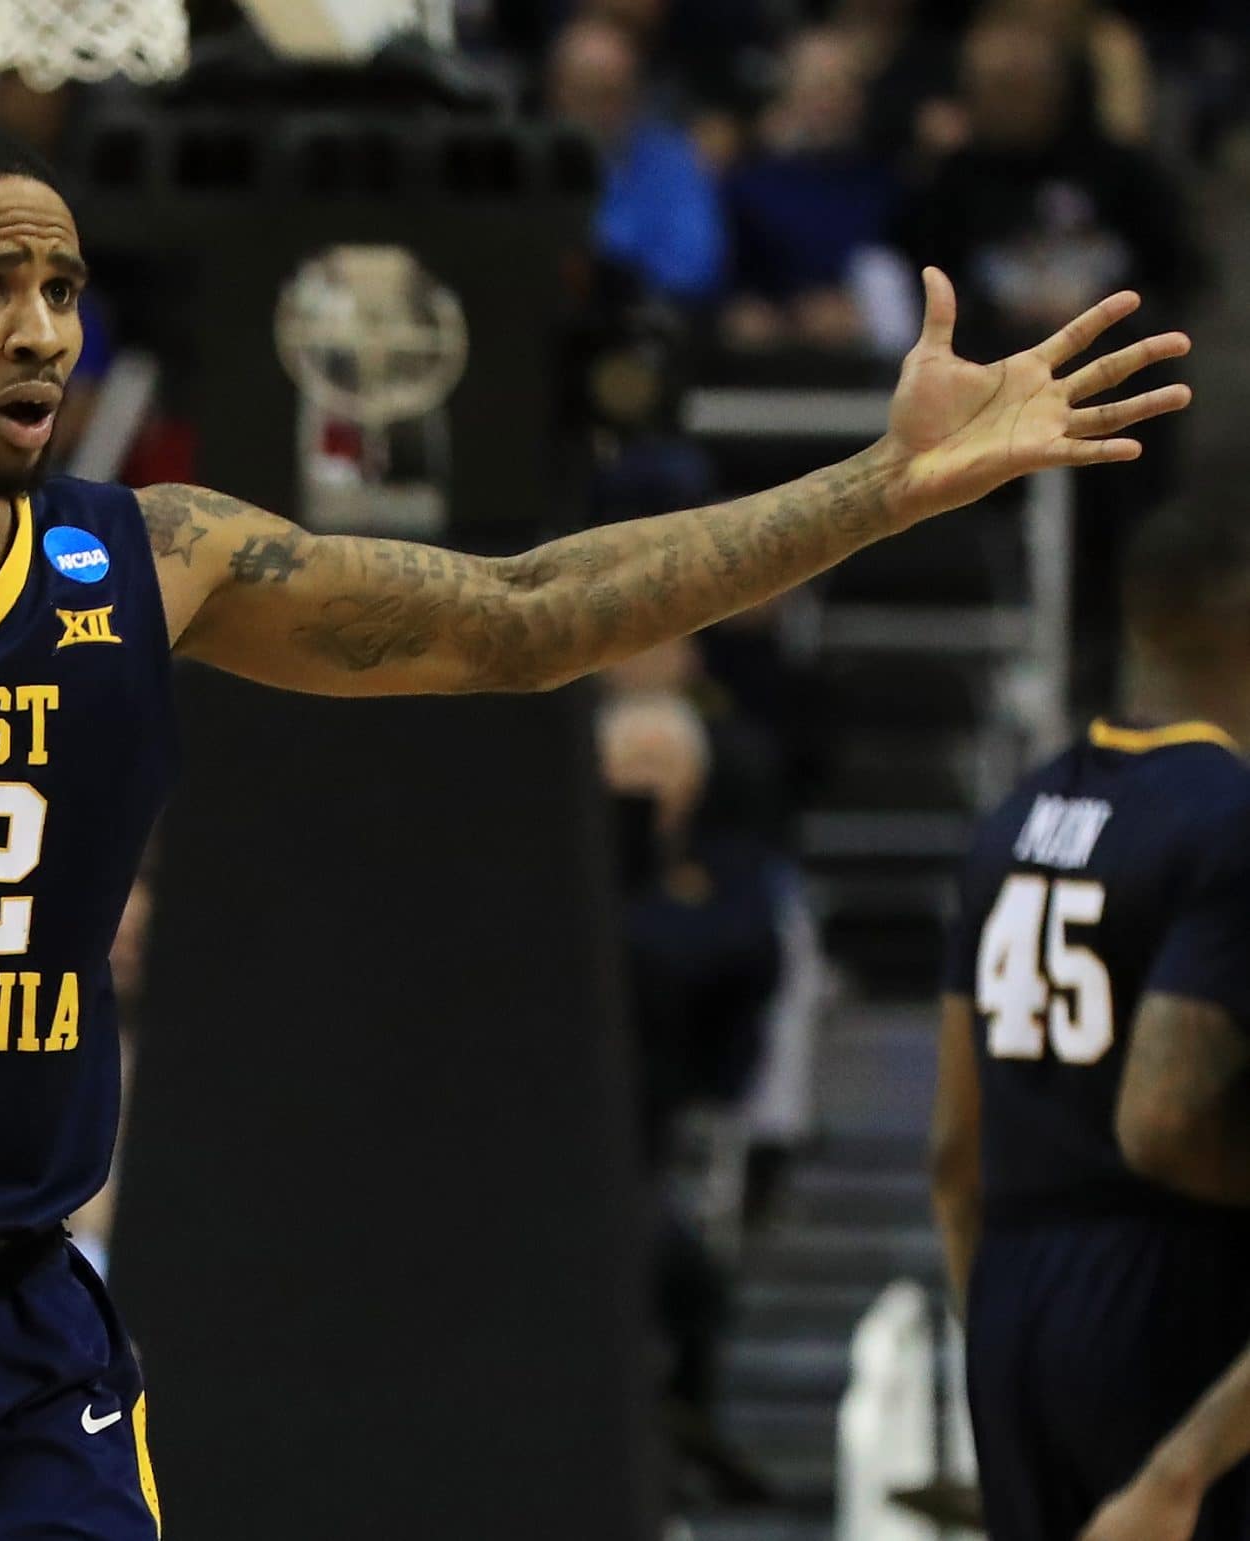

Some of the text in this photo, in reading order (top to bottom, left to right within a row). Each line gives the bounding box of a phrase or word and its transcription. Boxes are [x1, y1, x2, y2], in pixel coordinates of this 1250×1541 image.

[56, 548, 110, 570] NCAA
[56, 604, 122, 649] XII
[975, 872, 1114, 1065] 45
